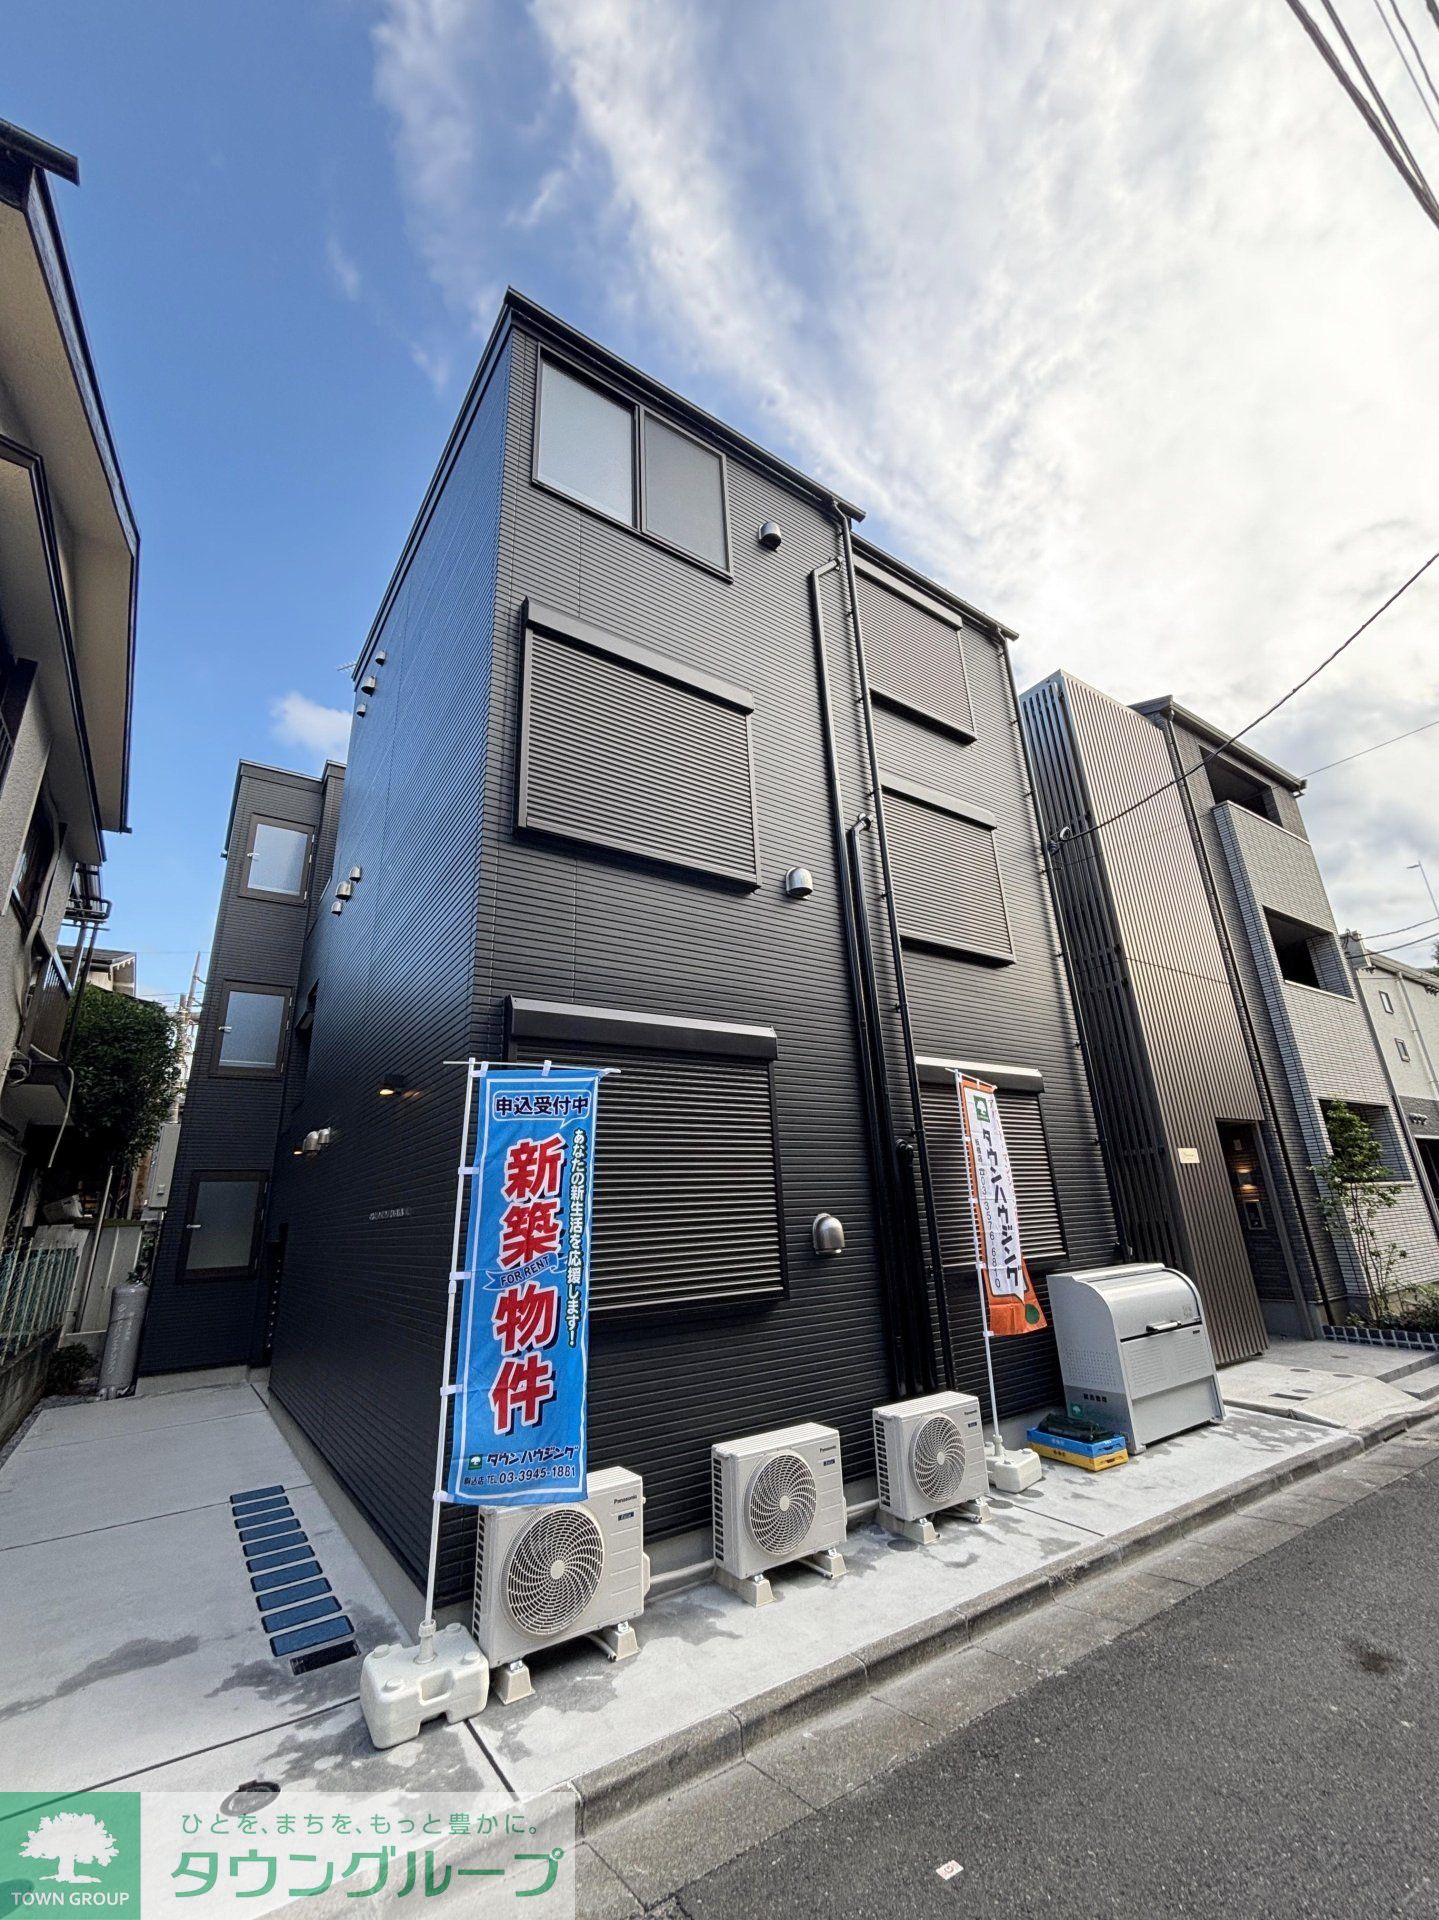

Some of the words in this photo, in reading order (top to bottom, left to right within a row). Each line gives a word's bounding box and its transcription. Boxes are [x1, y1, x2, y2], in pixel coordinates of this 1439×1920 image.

[495, 1095, 589, 1115] 申込受付中
[983, 1128, 1021, 1287] タウンハウジング
[500, 1270, 522, 1287] FOR
[523, 1255, 549, 1278] RENT
[486, 1446, 579, 1467] タウンハウジング
[487, 1475, 498, 1485] TEL
[499, 1464, 576, 1484] 03-3945-1881
